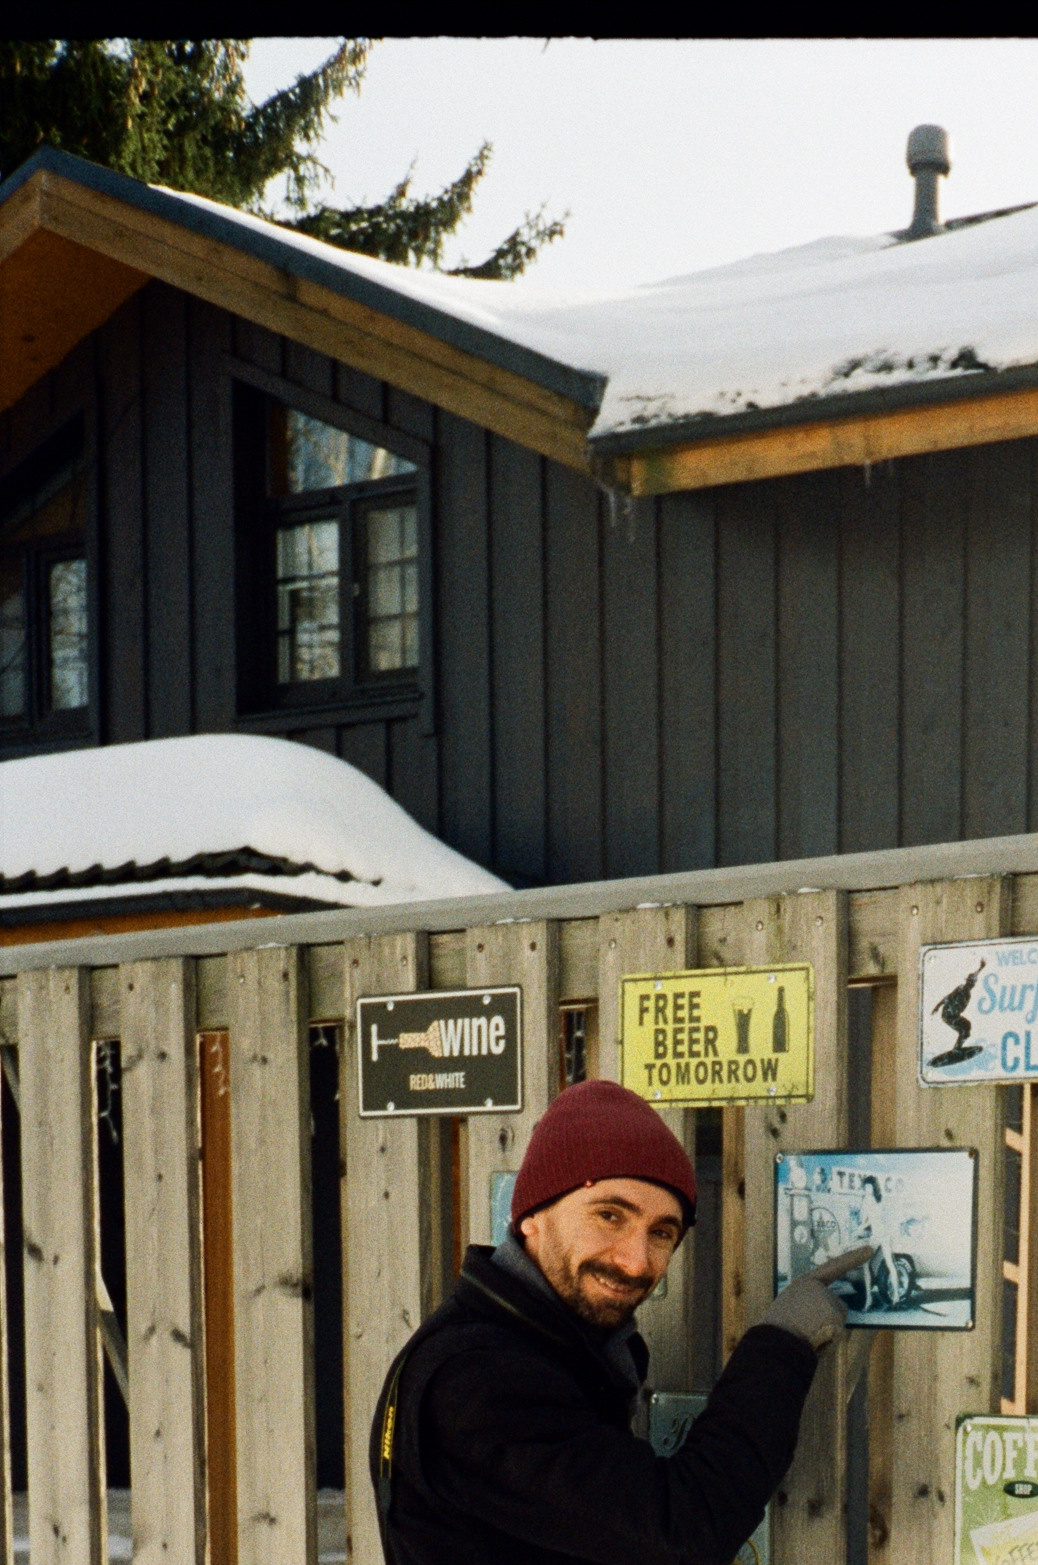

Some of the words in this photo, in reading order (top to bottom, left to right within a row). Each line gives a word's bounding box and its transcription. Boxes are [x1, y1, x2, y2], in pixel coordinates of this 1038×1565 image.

[638, 990, 702, 1027] FREE
[653, 1025, 720, 1060] BEER
[409, 1072, 466, 1091] RED&WHITE
[644, 1057, 780, 1087] TOMORROW
[836, 1170, 905, 1193] TEXCO
[383, 1405, 395, 1460] Nikon
[1014, 1483, 1033, 1495] SHOP
